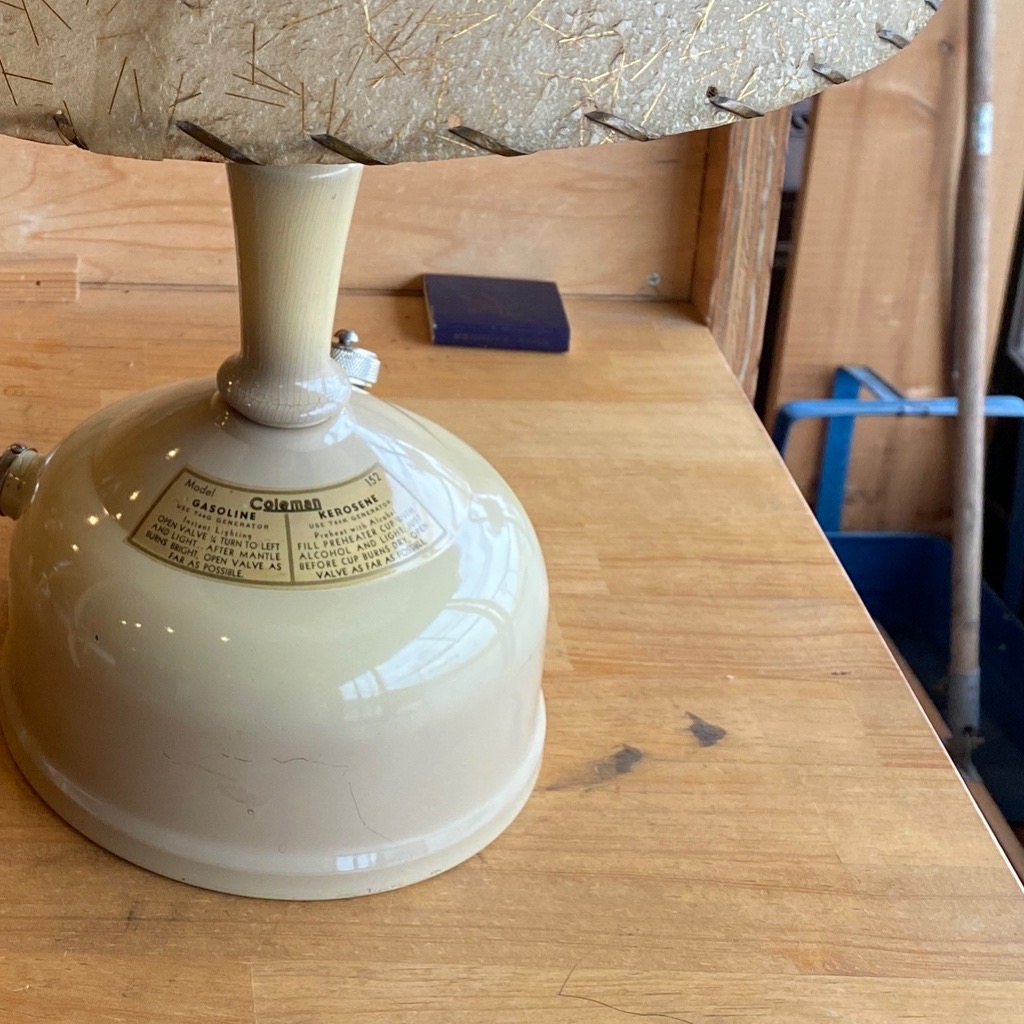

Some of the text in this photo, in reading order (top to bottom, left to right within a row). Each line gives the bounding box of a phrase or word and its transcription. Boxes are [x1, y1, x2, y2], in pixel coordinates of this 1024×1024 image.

[185, 472, 382, 497] Model 152
[176, 503, 191, 513] USE
[216, 517, 269, 529] GENERATOR
[192, 499, 256, 520] GASOLINE
[249, 496, 322, 513] Coleman
[318, 494, 378, 519] KEROSENE
[351, 500, 391, 521] GENERATOR
[158, 515, 178, 529] OPEN
[180, 524, 207, 540] VALVE
[221, 537, 242, 547] TURN
[246, 540, 257, 549] TO
[261, 542, 280, 551] LEFT
[183, 516, 252, 540] Instant Lighting
[297, 542, 319, 551] FILL
[323, 528, 378, 547] PREHEATER
[379, 520, 395, 533] CUP
[314, 529, 347, 539] Preheat
[350, 523, 367, 533] with
[146, 530, 168, 546] BURNS
[204, 553, 227, 565] OPEN
[232, 558, 264, 570] VALVE
[269, 563, 282, 571] AS
[151, 523, 169, 536] AND
[206, 544, 234, 557] AFTER
[240, 551, 281, 561] MANTLE
[299, 547, 351, 560] ALCOHOL
[357, 539, 377, 552] AND
[168, 552, 185, 564] FAR
[187, 560, 200, 569] AS
[299, 559, 337, 570] BEFORE
[341, 555, 358, 566] CUP
[362, 545, 391, 561] BURNS
[316, 567, 348, 579] VALVE
[352, 564, 364, 574] AS
[365, 559, 382, 570] FAR
[386, 554, 396, 564] AS
